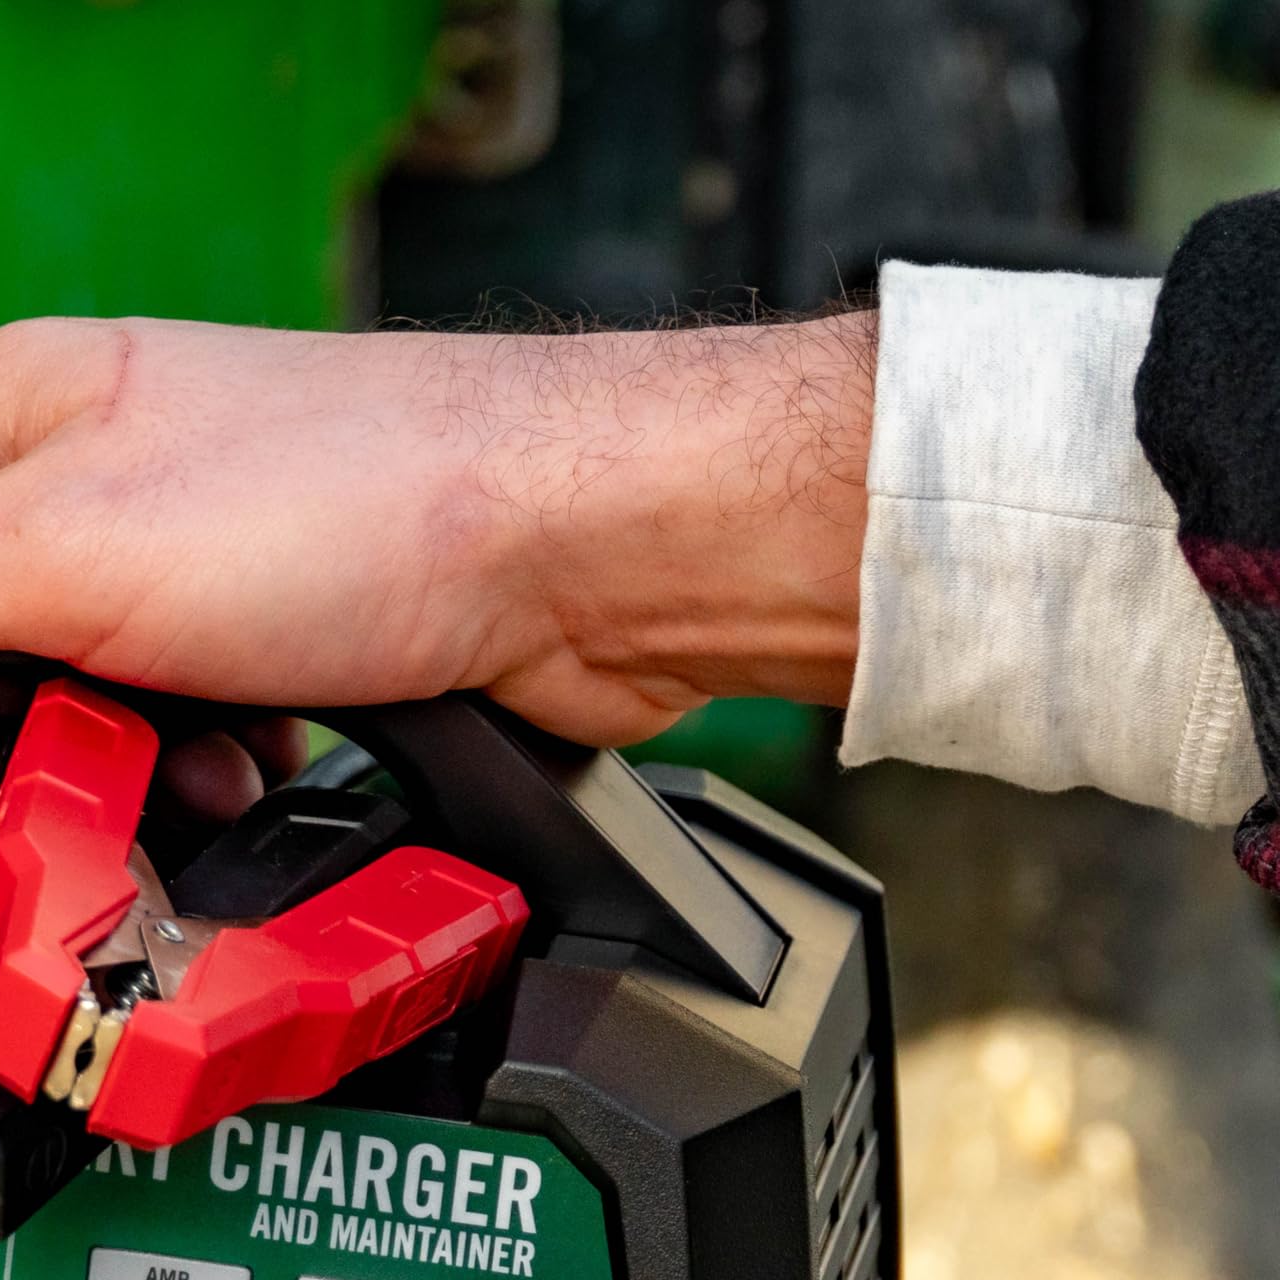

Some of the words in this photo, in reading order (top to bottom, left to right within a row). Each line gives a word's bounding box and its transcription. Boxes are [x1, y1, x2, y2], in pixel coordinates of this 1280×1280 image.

[209, 1116, 543, 1234] CHARGER
[250, 1202, 319, 1246] AND
[329, 1213, 537, 1278] MAINTAINER
